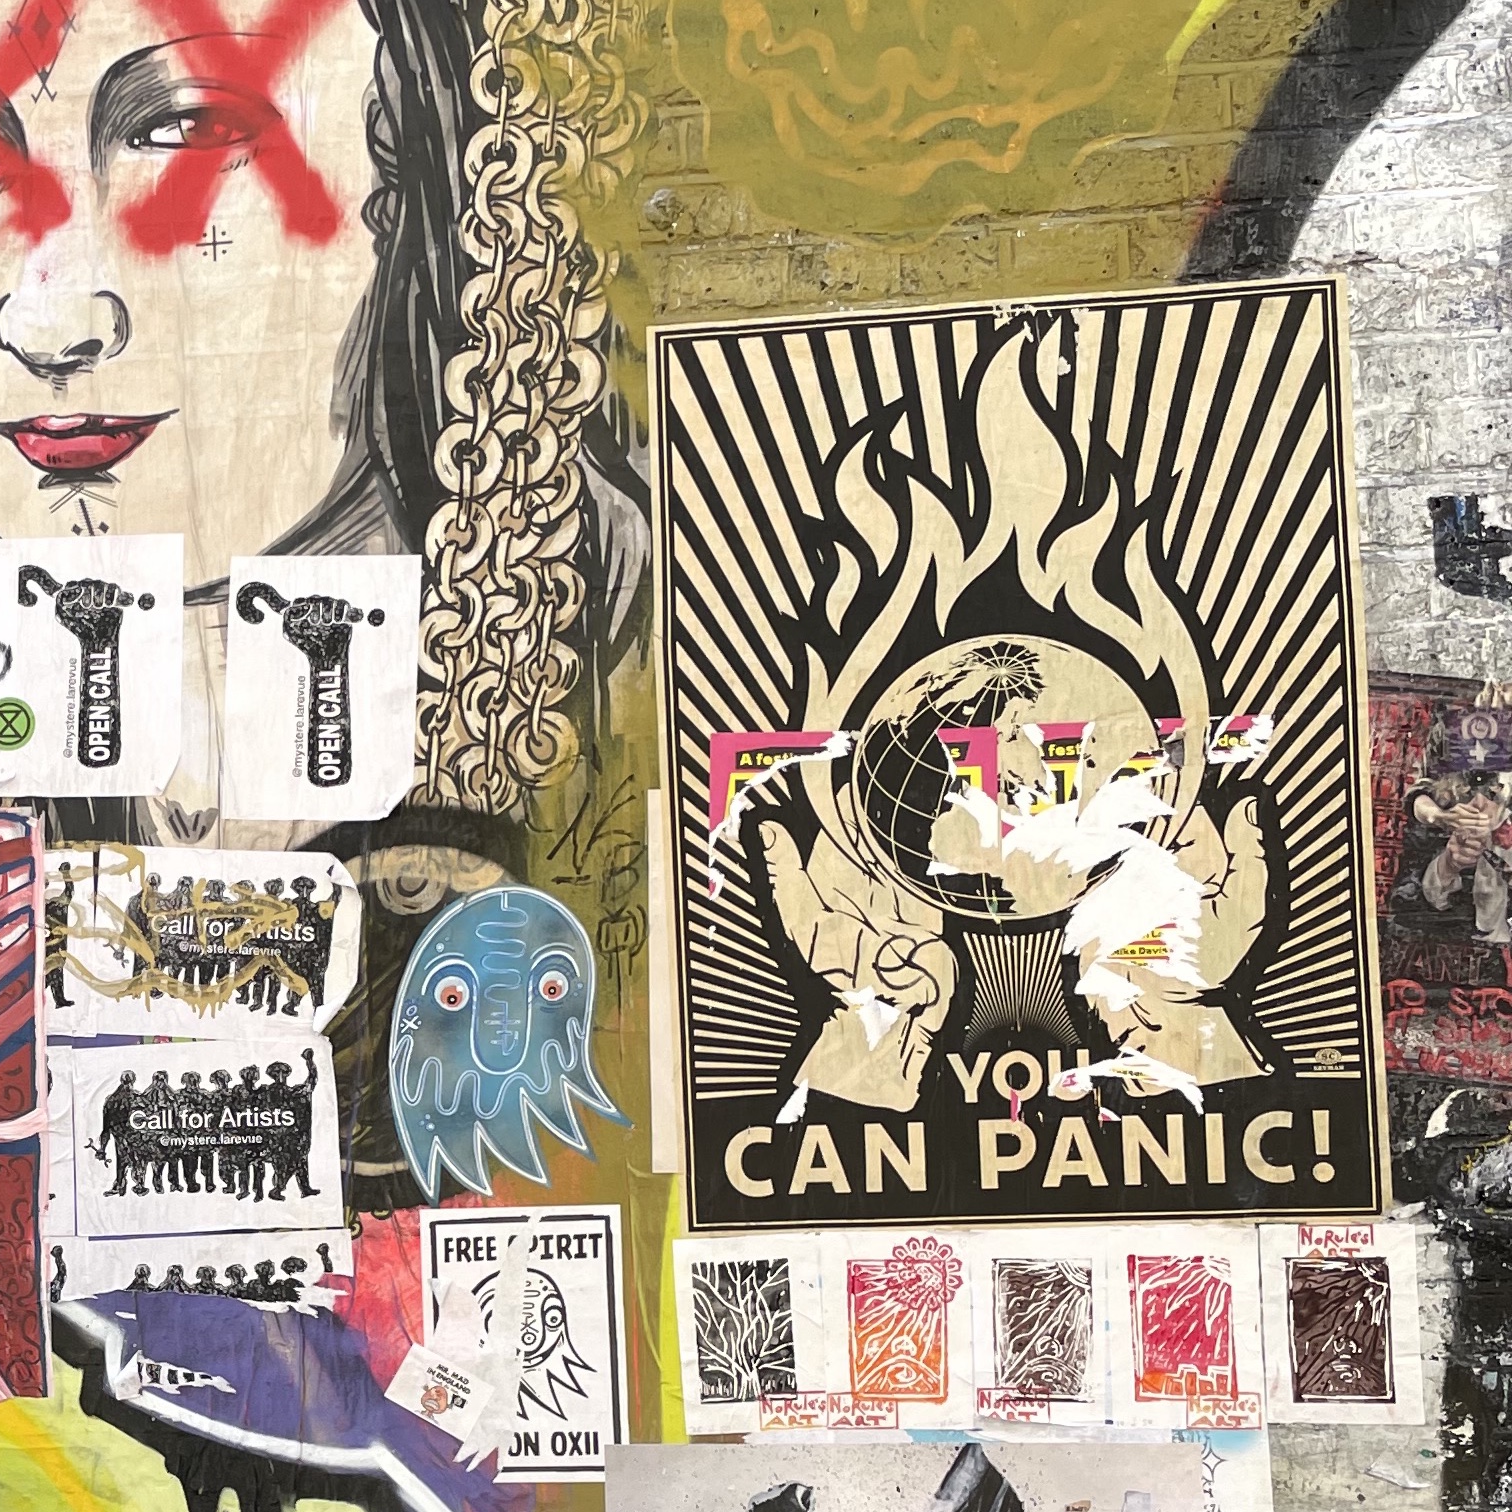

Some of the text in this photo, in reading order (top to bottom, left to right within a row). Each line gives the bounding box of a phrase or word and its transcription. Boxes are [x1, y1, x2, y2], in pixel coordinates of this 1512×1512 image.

[62, 657, 78, 759] @mystere.larevue
[88, 646, 112, 761] OPEN CALL
[291, 675, 306, 778] @mystere.larevue
[317, 664, 342, 781] OPEN CALL
[739, 752, 753, 766] A
[150, 914, 194, 937] Call
[202, 914, 232, 937] for
[946, 1048, 1091, 1104] YOU
[129, 1105, 296, 1130] Call for Artists
[159, 1133, 263, 1149] @mystere.larevue
[723, 1109, 1336, 1198] CAN PANIC!
[443, 1232, 603, 1264] FREE IRIT
[764, 1414, 819, 1426] ART
[831, 1415, 887, 1427] ART
[1190, 1415, 1249, 1429] ART
[550, 1430, 600, 1457] OXII
